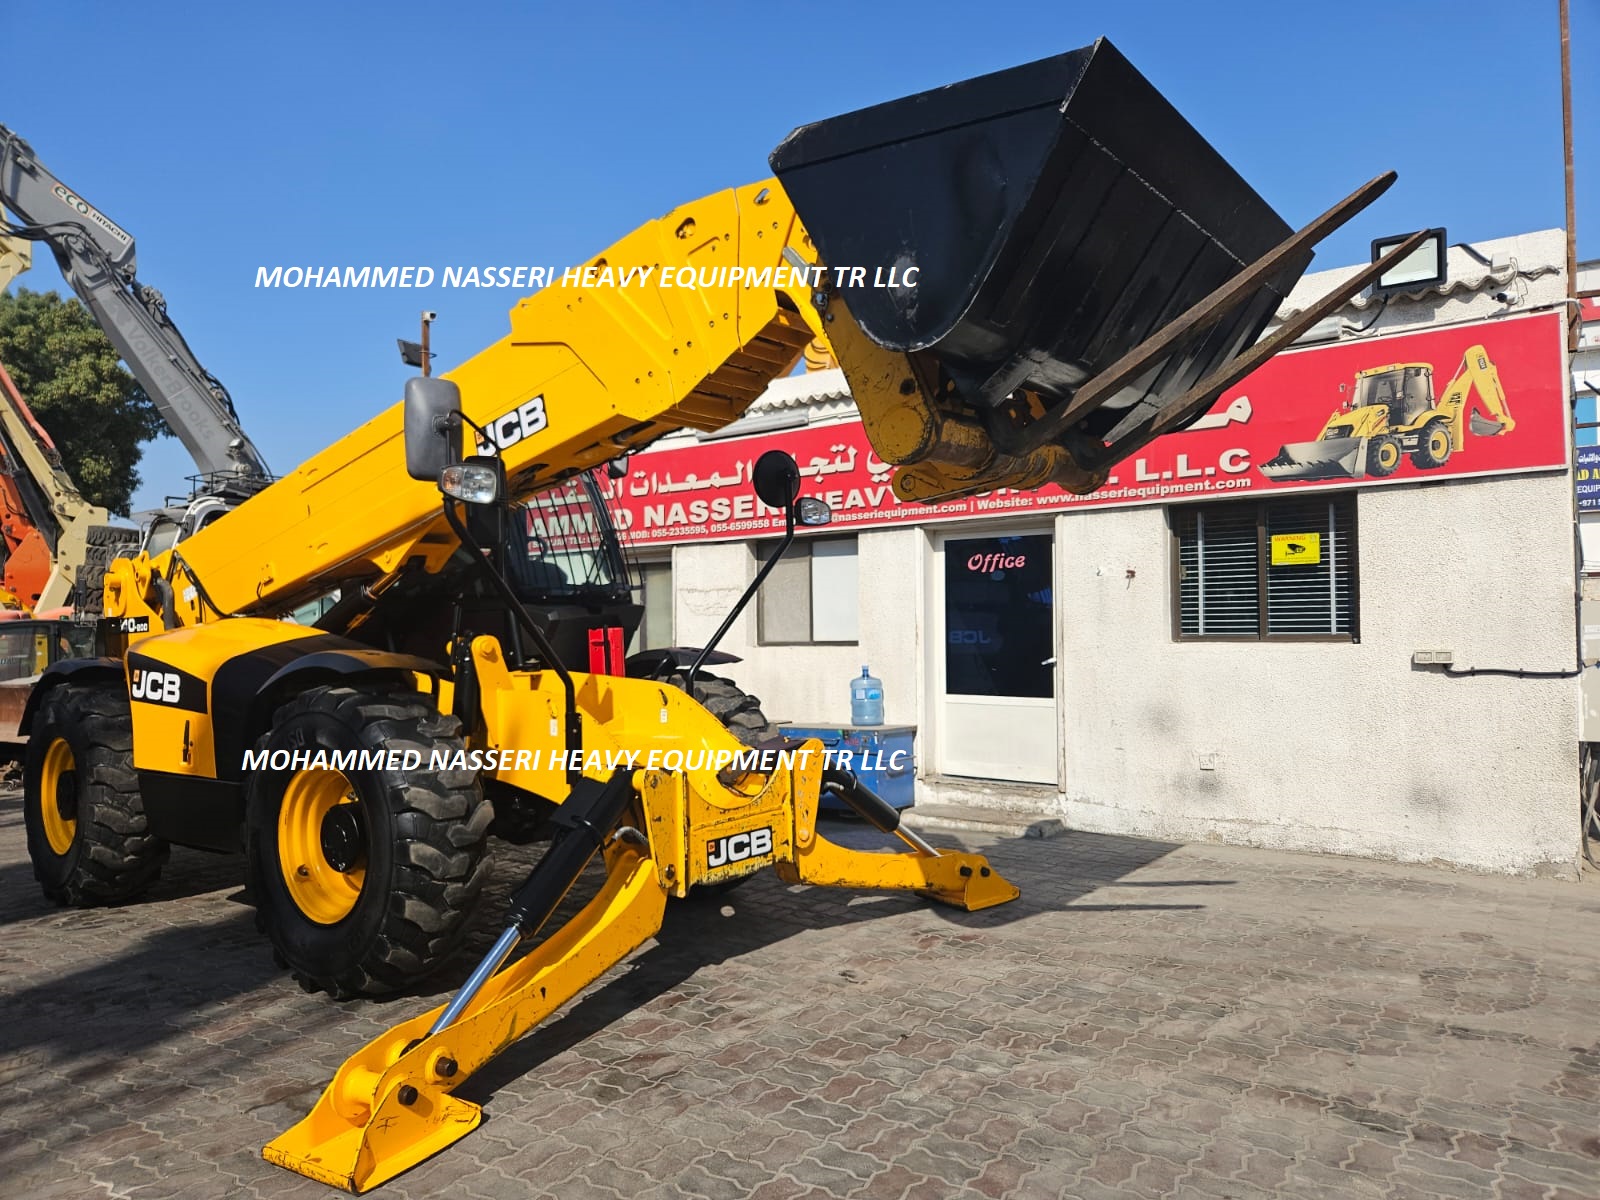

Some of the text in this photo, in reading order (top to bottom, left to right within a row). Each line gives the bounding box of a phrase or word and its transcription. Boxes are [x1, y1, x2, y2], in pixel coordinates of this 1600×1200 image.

[91, 211, 128, 242] HITACHI
[477, 396, 547, 457] JCB
[711, 519, 769, 533] 055-6599558
[977, 497, 1033, 510] Website:
[967, 553, 1026, 573] Office
[132, 670, 181, 703] JCB
[708, 828, 773, 868] JCB
